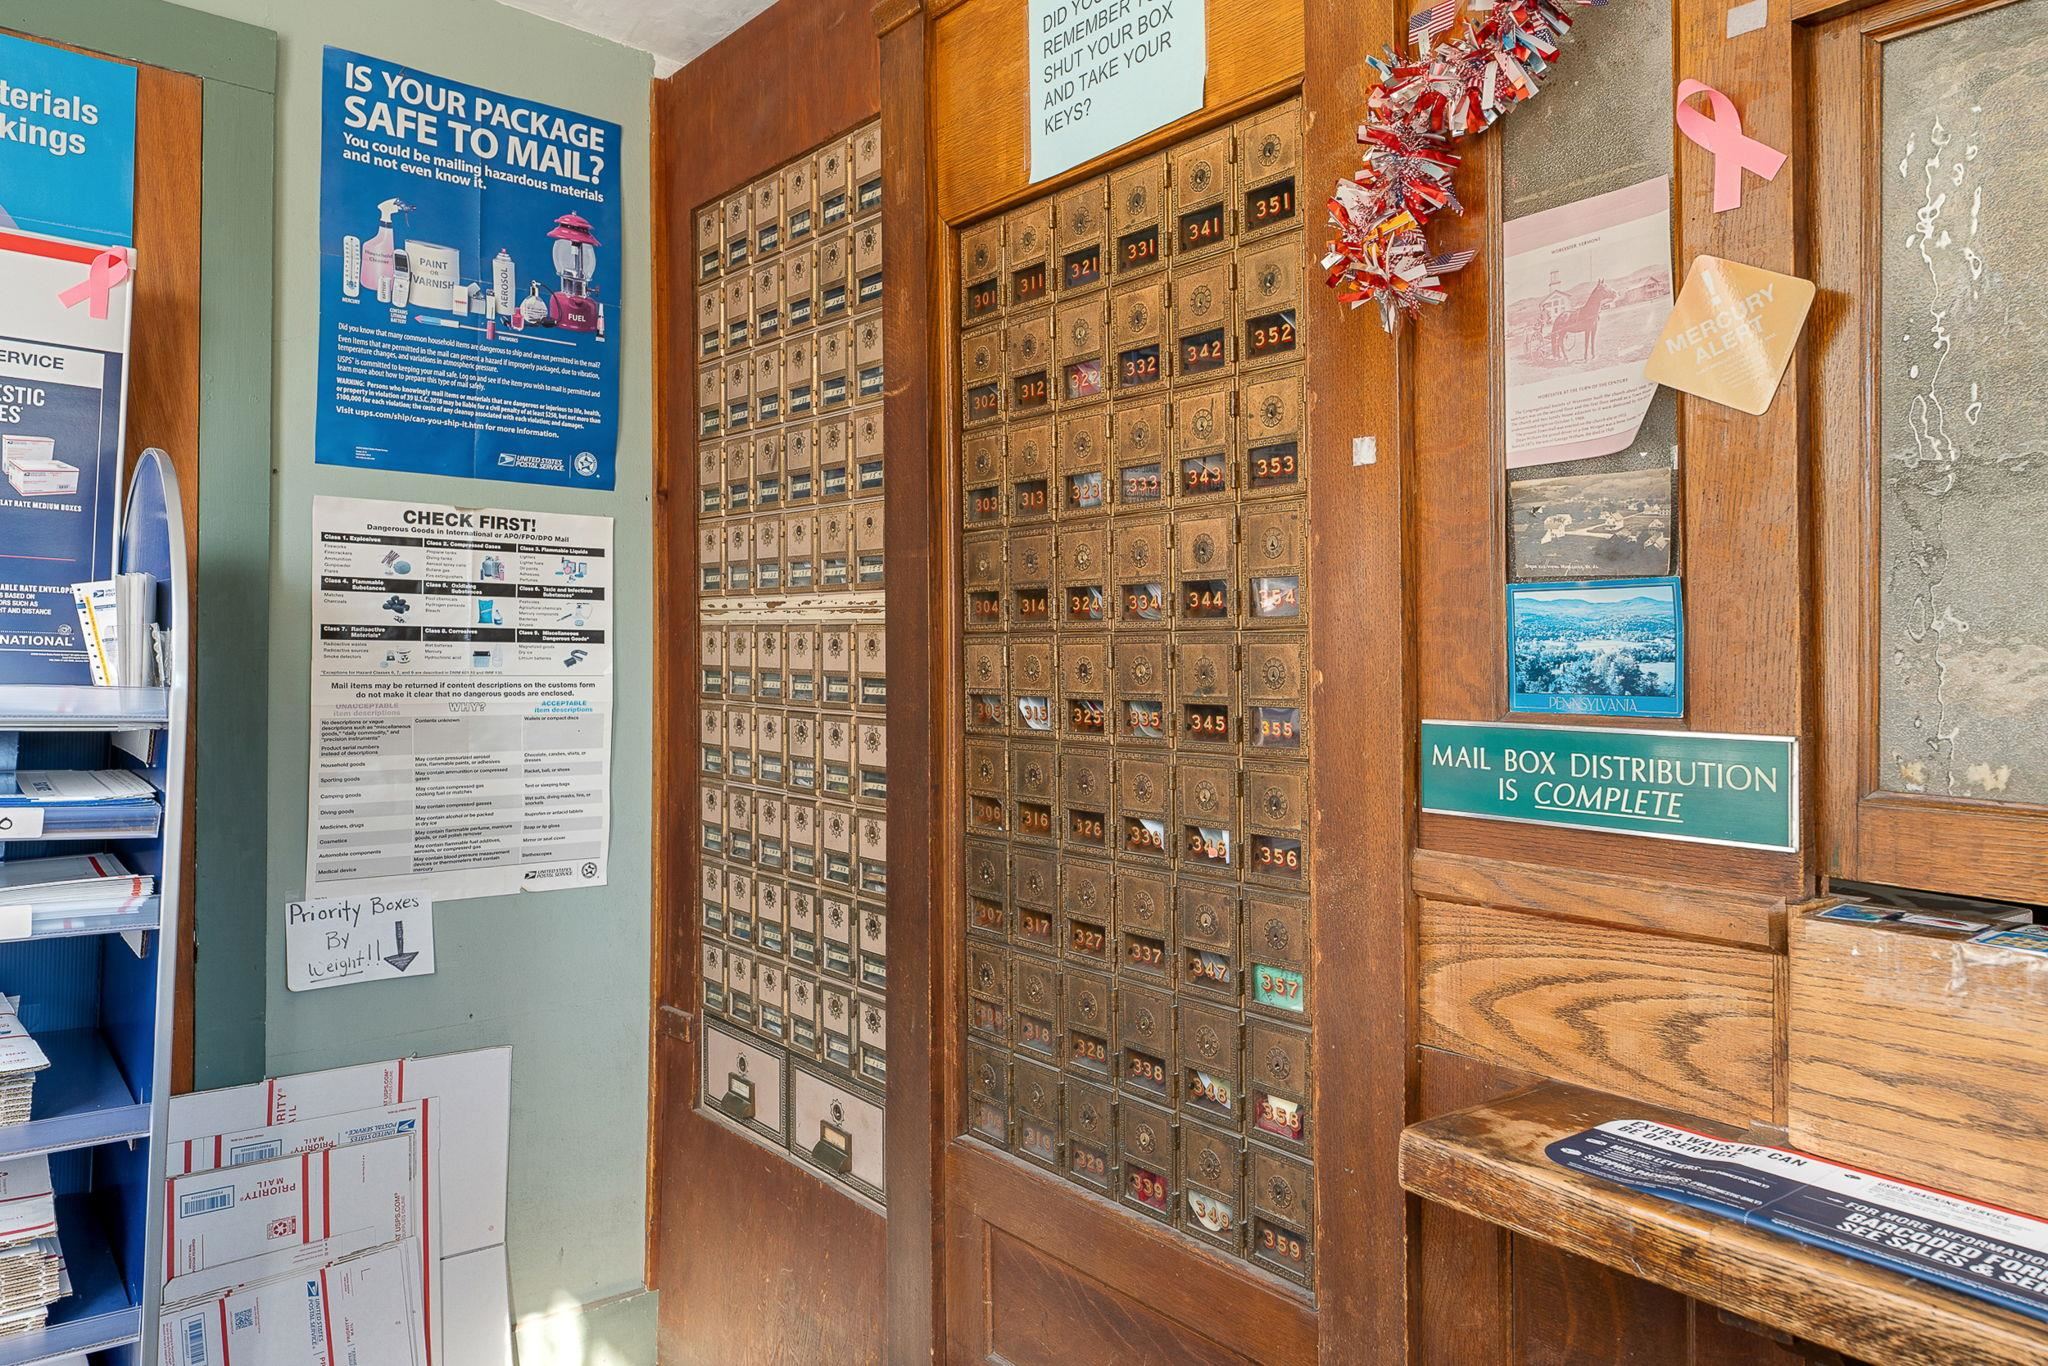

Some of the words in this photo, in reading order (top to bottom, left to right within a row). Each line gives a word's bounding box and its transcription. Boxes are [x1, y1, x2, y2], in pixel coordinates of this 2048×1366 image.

[1043, 6, 1067, 33] DID
[1044, 0, 1130, 58] REMEMBER
[1044, 49, 1082, 83] SHUT
[1088, 23, 1133, 60] YOUR
[1138, 2, 1173, 36] BOX
[1044, 81, 1074, 110] AND
[1079, 58, 1119, 91] TAKE
[1124, 31, 1172, 68] YOUR
[346, 62, 372, 92] IS
[382, 72, 466, 118] YOUR
[475, 98, 604, 152] PACKAGE
[1045, 98, 1092, 135] KEYS?
[344, 96, 438, 147] SAFE
[448, 120, 498, 159] TO
[507, 135, 604, 184] MAIL?
[343, 132, 368, 149] You
[372, 139, 410, 160] could
[414, 148, 430, 163] be
[434, 154, 481, 176] mailing
[485, 165, 547, 190] hazardous
[550, 181, 603, 202] materials
[343, 148, 370, 163] and
[374, 156, 397, 170] not
[400, 164, 432, 179] even
[436, 168, 470, 187] know
[474, 176, 486, 190] it.
[1256, 192, 1291, 218] 351
[1189, 217, 1220, 241] 341
[1128, 239, 1155, 260] 331
[420, 258, 448, 270] PAINT
[1072, 257, 1098, 280] 321
[413, 274, 454, 290] VARNISH
[1021, 273, 1043, 295] 311
[974, 290, 996, 311] 301
[568, 312, 586, 323] FUEL
[1664, 283, 1777, 355] MERCURY
[338, 322, 348, 330] Did
[360, 327, 375, 335] know
[376, 329, 387, 337] that
[388, 332, 403, 340] many
[428, 337, 455, 347] household
[1254, 323, 1293, 347] 352
[1695, 315, 1764, 366] ALERT
[1188, 340, 1221, 363] 342
[1126, 356, 1157, 377] 332
[1022, 381, 1044, 399] 312
[336, 406, 354, 416] Visit
[355, 410, 484, 431] usps.com/ship/can-you-ship-it.htm
[486, 423, 496, 431] for
[497, 425, 515, 433] more
[517, 426, 559, 438] information.
[517, 455, 540, 463] UNITED
[541, 457, 562, 465] STATES
[1258, 456, 1294, 477] 353
[1129, 475, 1158, 494] 333
[1189, 467, 1222, 486] 343
[1022, 490, 1044, 507] 313
[1073, 483, 1101, 500] 323
[14, 500, 31, 508] RATE
[32, 502, 59, 510] MEDIUM
[60, 504, 82, 512] BOXES
[403, 510, 473, 528] CHECK
[480, 516, 536, 533] FIRST!
[366, 524, 409, 533] Dangerous
[411, 527, 434, 535] Goods
[446, 529, 493, 538] International
[504, 531, 553, 542] APO/FPO/DPO
[555, 534, 569, 543] Mail
[1022, 598, 1045, 614] 314
[1072, 596, 1100, 612] 324
[1129, 595, 1160, 612] 334
[1190, 591, 1224, 608] 344
[477, 682, 521, 690] descriptions
[449, 702, 486, 712] WHY?
[1549, 696, 1638, 712] PENNSYLVANIA
[1074, 708, 1102, 725] 325
[1130, 711, 1160, 728] 335
[1192, 714, 1227, 732] 345
[1261, 720, 1293, 737] 355
[1432, 744, 1491, 771] MAIL
[1504, 749, 1556, 776] BOX
[1570, 753, 1777, 793] DISTRIBUTION
[1499, 778, 1518, 802] IS
[1534, 781, 1684, 818] COMPLETE
[1024, 811, 1048, 828] 316
[1132, 826, 1162, 848] 336
[1261, 847, 1297, 869] 356
[290, 900, 360, 928] Priority
[370, 897, 419, 915] Boxes
[1026, 917, 1049, 934] 317
[326, 931, 349, 950] By
[1076, 929, 1102, 948] 327
[1132, 943, 1162, 964] 337
[1193, 958, 1227, 983] 347
[1261, 974, 1298, 998] 357
[1078, 1039, 1105, 1062] 328
[1134, 1058, 1163, 1083] 338
[1194, 1078, 1228, 1104] 348
[1263, 1102, 1300, 1130] 358
[1618, 1126, 1641, 1135] BE
[1644, 1131, 1664, 1142] OF
[1666, 1139, 1742, 1159] SERVICE
[1630, 1121, 1681, 1140] EXTRA
[1686, 1136, 1733, 1150] WAYS
[1737, 1146, 1765, 1155] WE
[1767, 1152, 1808, 1167] CAN
[257, 1177, 284, 1188] MAIL
[1133, 1174, 1163, 1199] 339
[1197, 1200, 1230, 1230] 349
[1846, 1202, 1879, 1216] FOR
[1880, 1211, 1933, 1230] MORE
[1264, 1230, 1300, 1260] 359
[1845, 1213, 1984, 1259] BARCODED
[1836, 1221, 1888, 1242] SEE
[1885, 1238, 1972, 1268] SALES
[1969, 1264, 1994, 1277] &
